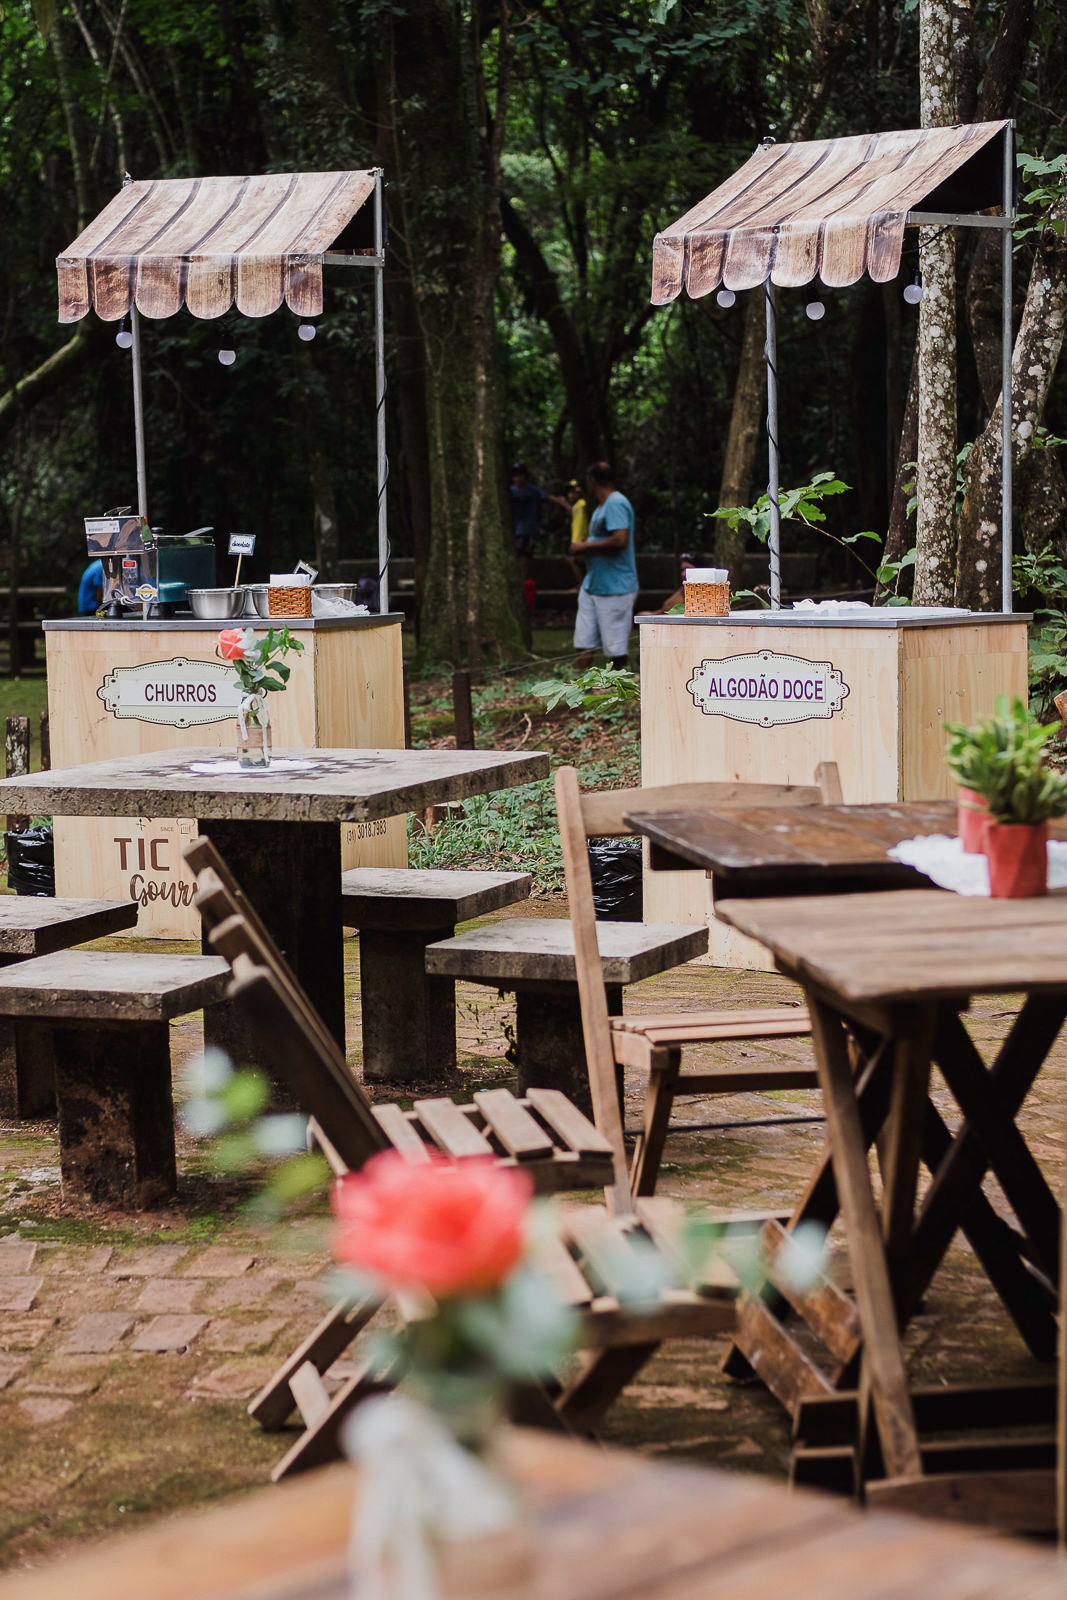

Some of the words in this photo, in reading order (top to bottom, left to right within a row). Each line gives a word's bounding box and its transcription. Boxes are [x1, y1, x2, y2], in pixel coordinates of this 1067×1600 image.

[144, 683, 217, 702] CHURROS
[708, 674, 779, 699] ALGODÃO
[783, 679, 824, 700] DOCE
[113, 837, 170, 871] TIC
[130, 873, 198, 908] Gour
